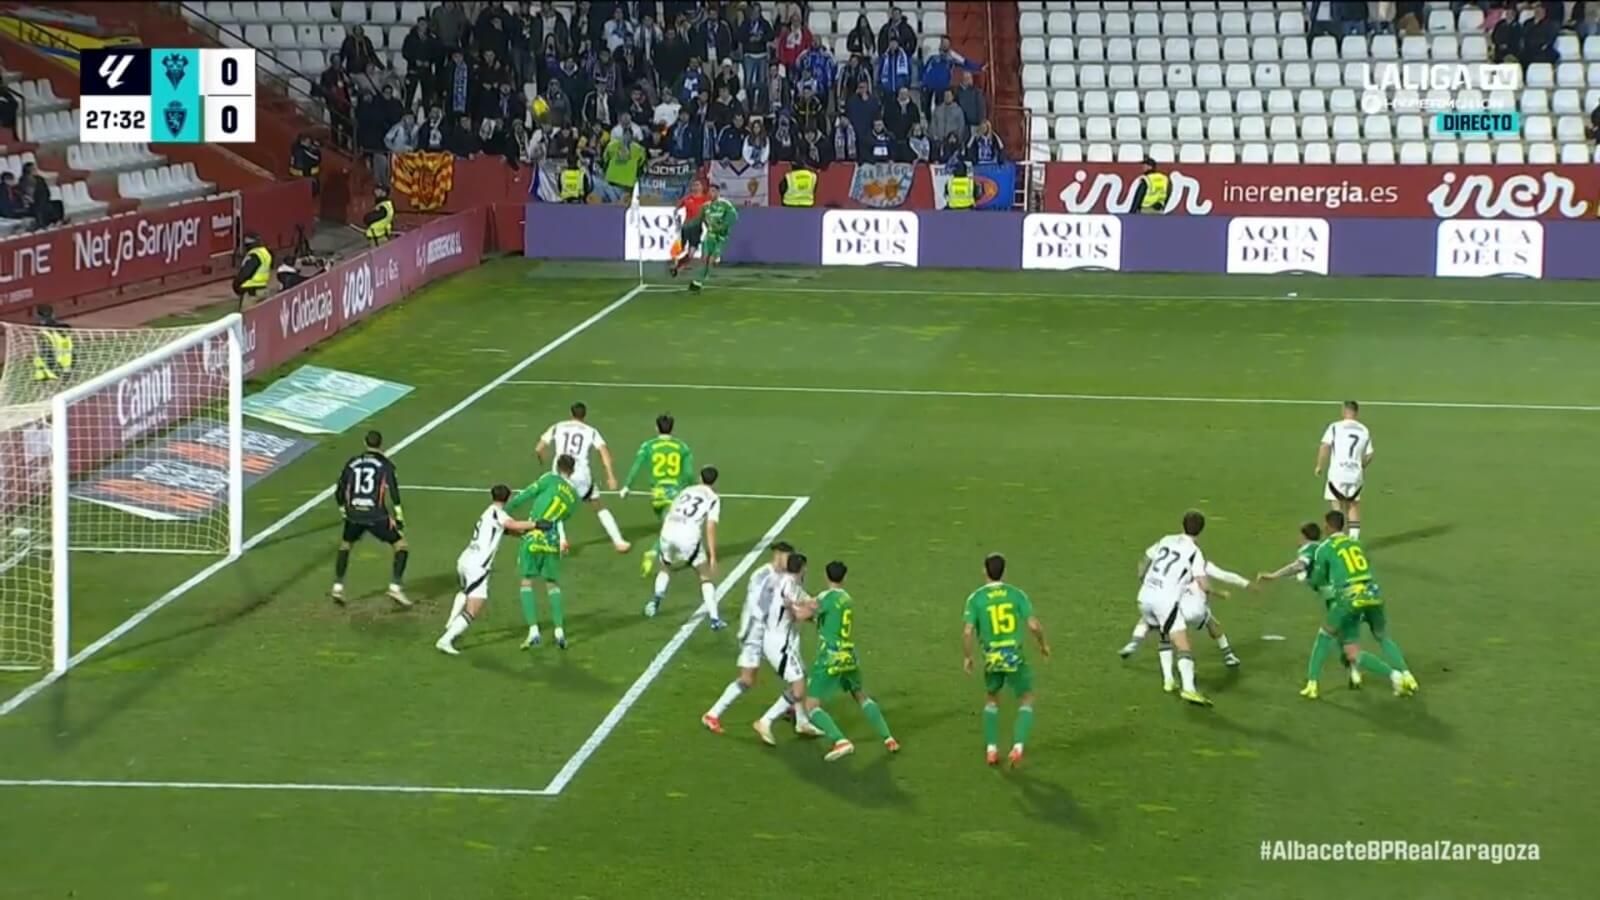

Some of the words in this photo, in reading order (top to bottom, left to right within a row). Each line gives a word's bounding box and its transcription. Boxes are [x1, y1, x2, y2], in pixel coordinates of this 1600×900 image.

[1223, 180, 1399, 208] inerenergia.es
[832, 217, 909, 236] AQUA
[1032, 221, 1111, 240] AQUA
[1238, 224, 1319, 244] AQUA
[1449, 228, 1532, 247] AQUA
[74, 228, 112, 271] Net
[836, 238, 906, 255] DEUS
[1036, 242, 1108, 259] DEUS
[1242, 246, 1315, 263] DEUS
[1452, 248, 1528, 266] DEUS
[290, 283, 333, 333] Globalcaja
[117, 362, 171, 426] Canon
[563, 432, 584, 455] 19
[1348, 433, 1359, 458] 7
[652, 452, 681, 477] 29
[353, 467, 376, 494] 13
[675, 493, 704, 518] 23
[1152, 546, 1181, 576] 27
[1337, 545, 1368, 573] 16
[841, 608, 852, 638] 5
[987, 602, 1015, 635] 15
